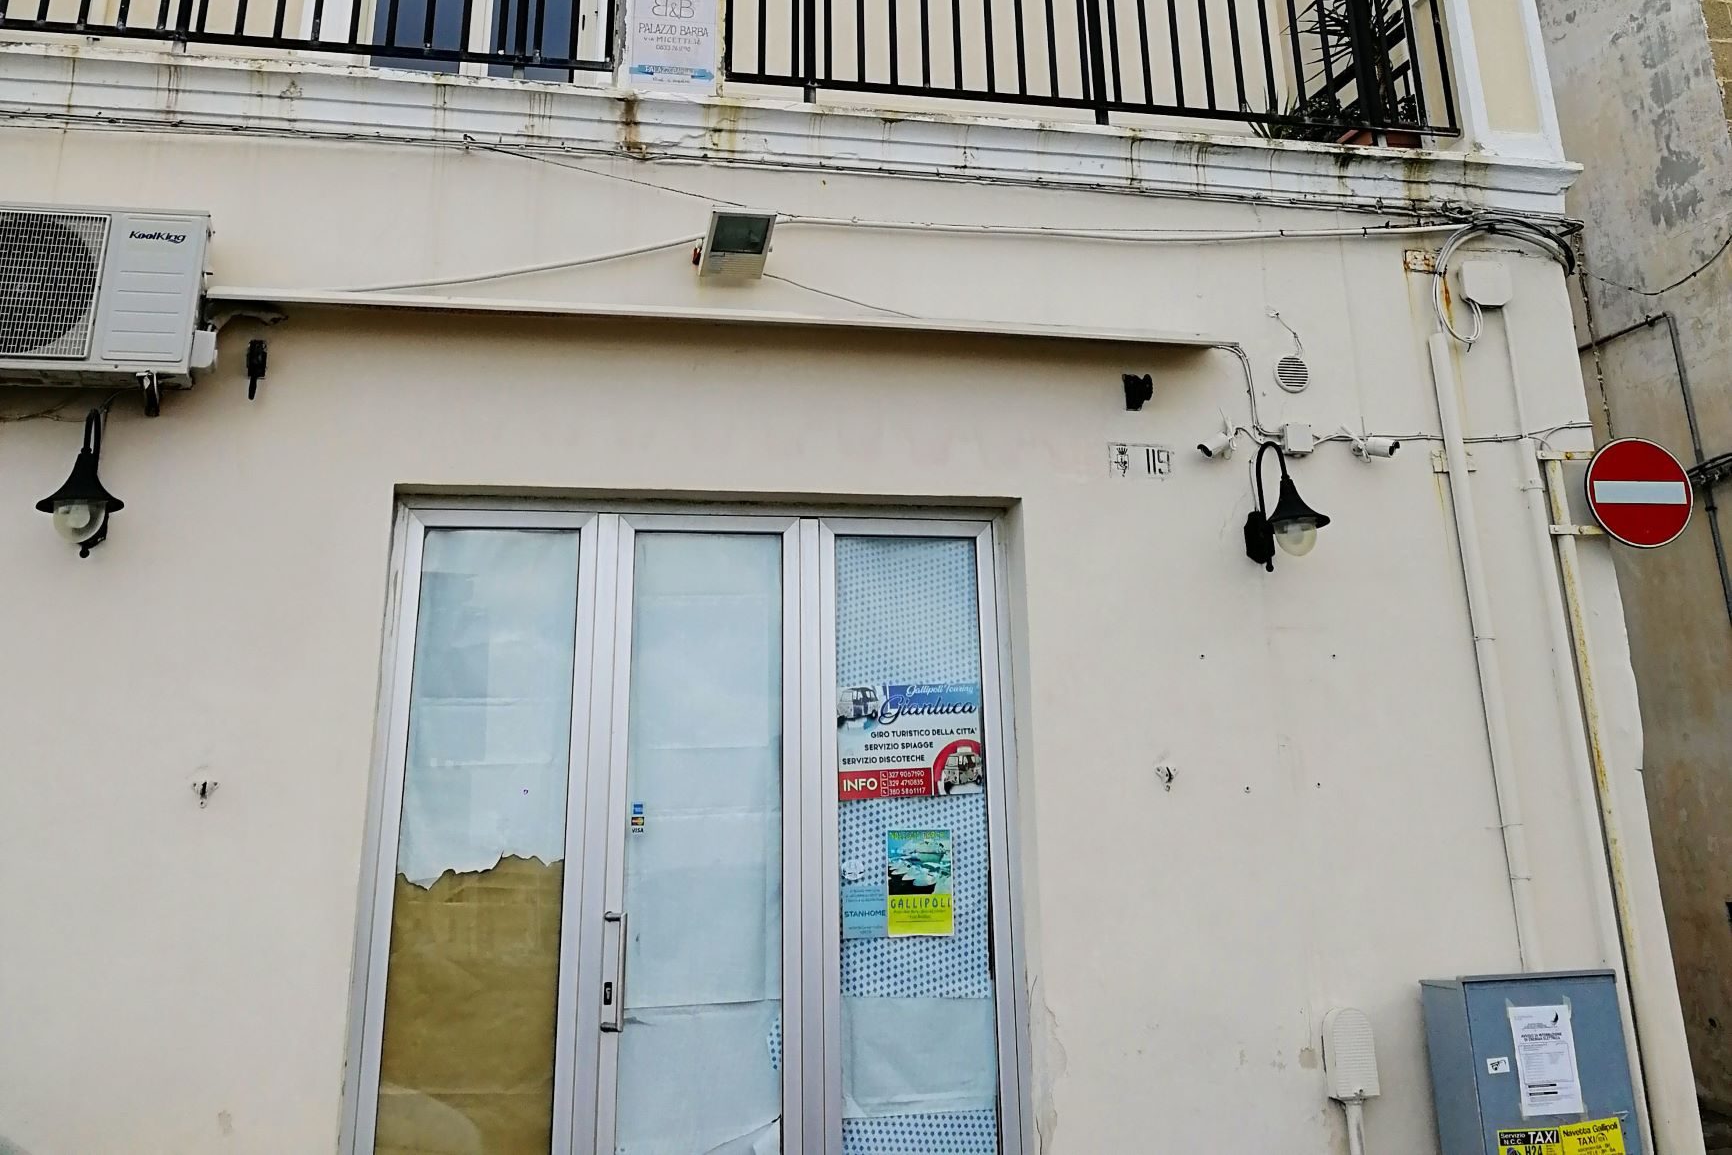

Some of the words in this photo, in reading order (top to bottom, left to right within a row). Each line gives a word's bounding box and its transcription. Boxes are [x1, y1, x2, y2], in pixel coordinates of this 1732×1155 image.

[638, 22, 677, 35] PALAZZO
[679, 25, 709, 37] BARBA
[128, 230, 187, 244] KoolKing
[906, 685, 944, 696] Gallipoli
[878, 695, 977, 725] Gianluca
[870, 731, 890, 739] GIRO
[892, 729, 931, 738] TURISTICO
[931, 728, 955, 736] DELLA
[864, 742, 899, 751] SERVIZIO
[900, 741, 934, 750] SPIAGGE
[842, 756, 878, 765] SERVIZIO
[879, 754, 925, 764] DISCOTECHE
[842, 777, 878, 792] INFO
[890, 897, 951, 909] GALLIPOLI
[844, 909, 887, 918] STANHOME
[1562, 1127, 1591, 1137] Navetta
[1592, 1121, 1618, 1133] Gallipoli
[1527, 1131, 1557, 1144] TAXI
[1577, 1135, 1596, 1146] TAXI
